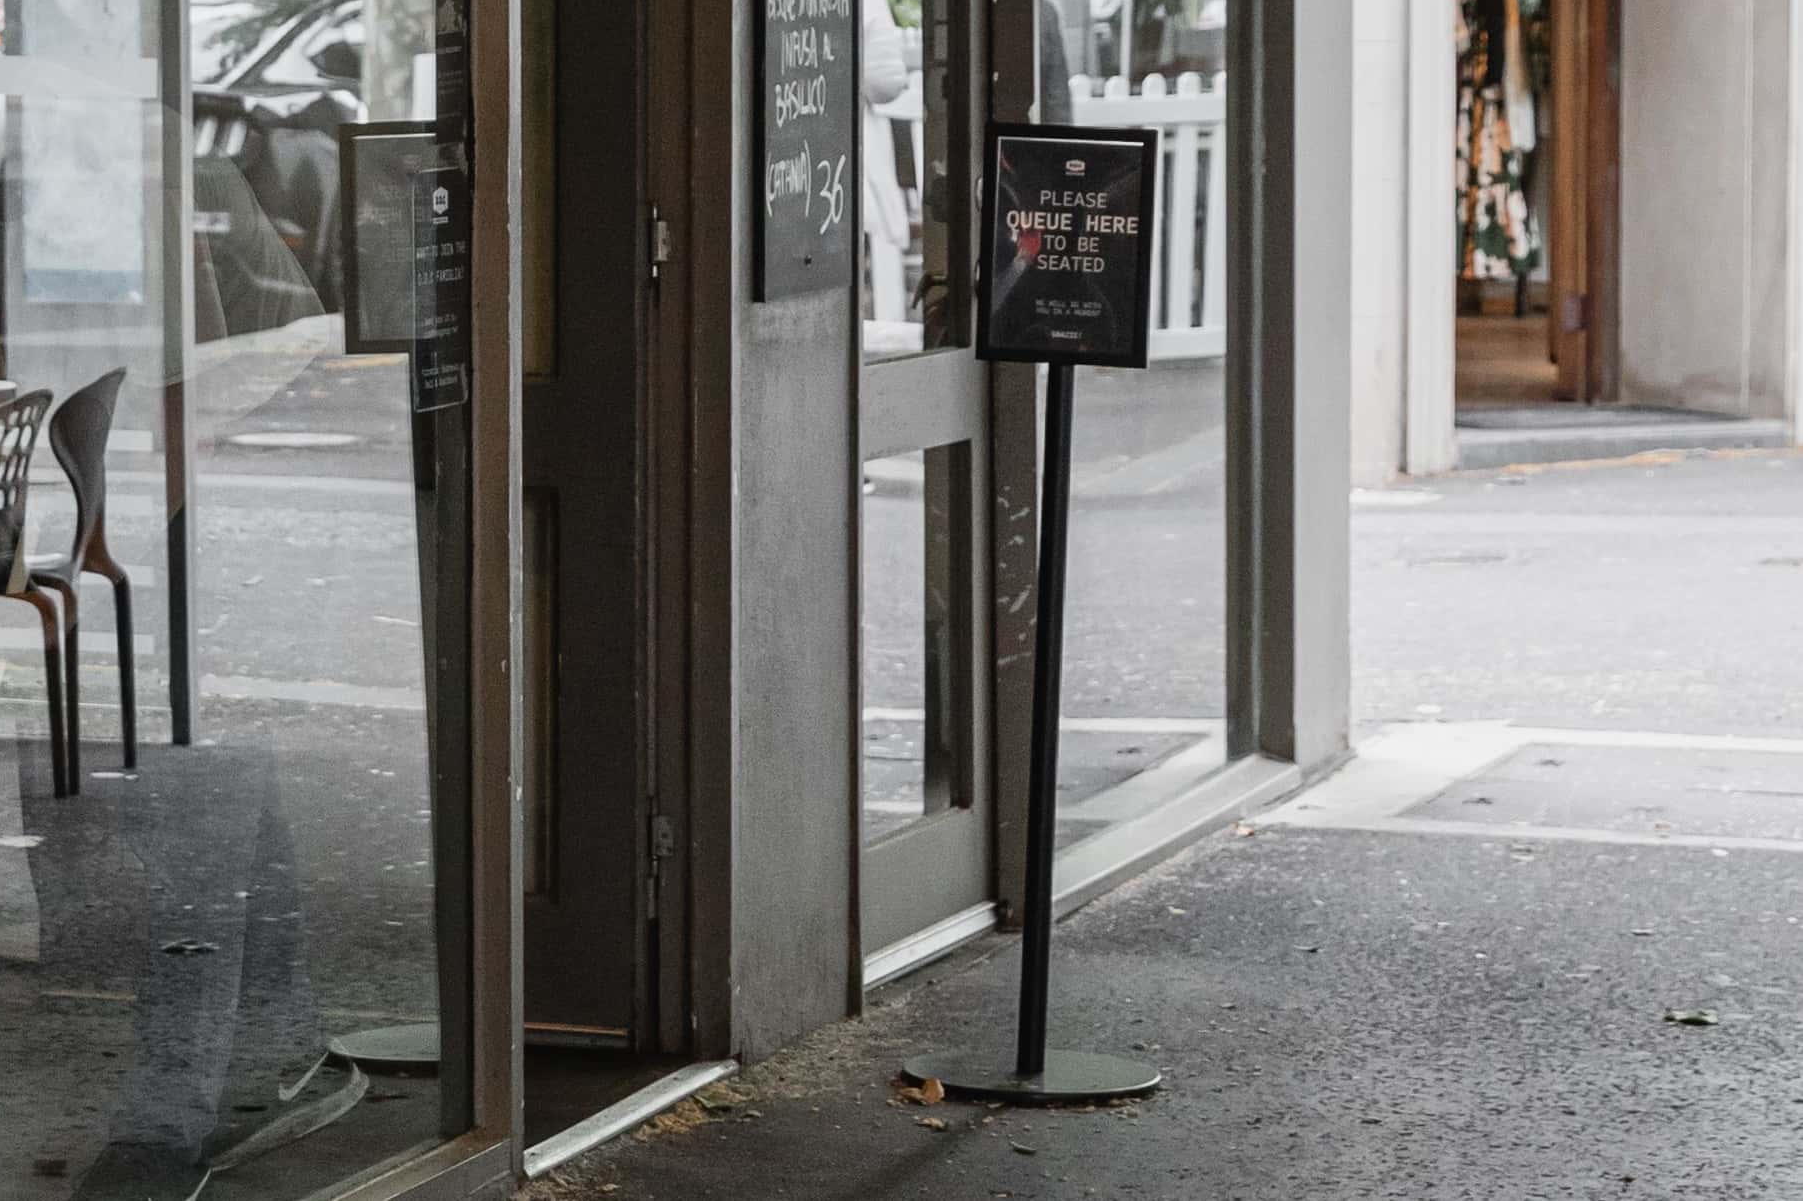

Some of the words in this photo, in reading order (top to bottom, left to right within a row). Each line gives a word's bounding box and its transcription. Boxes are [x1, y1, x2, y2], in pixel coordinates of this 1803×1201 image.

[780, 27, 819, 76] INFUSA
[816, 153, 847, 236] 36
[1039, 189, 1108, 209] PLEASE
[1006, 209, 1072, 231] QUEUE
[1086, 214, 1140, 235] HERE
[1044, 234, 1066, 250] TO
[1077, 236, 1100, 253] BE
[1037, 254, 1105, 273] SEATED
